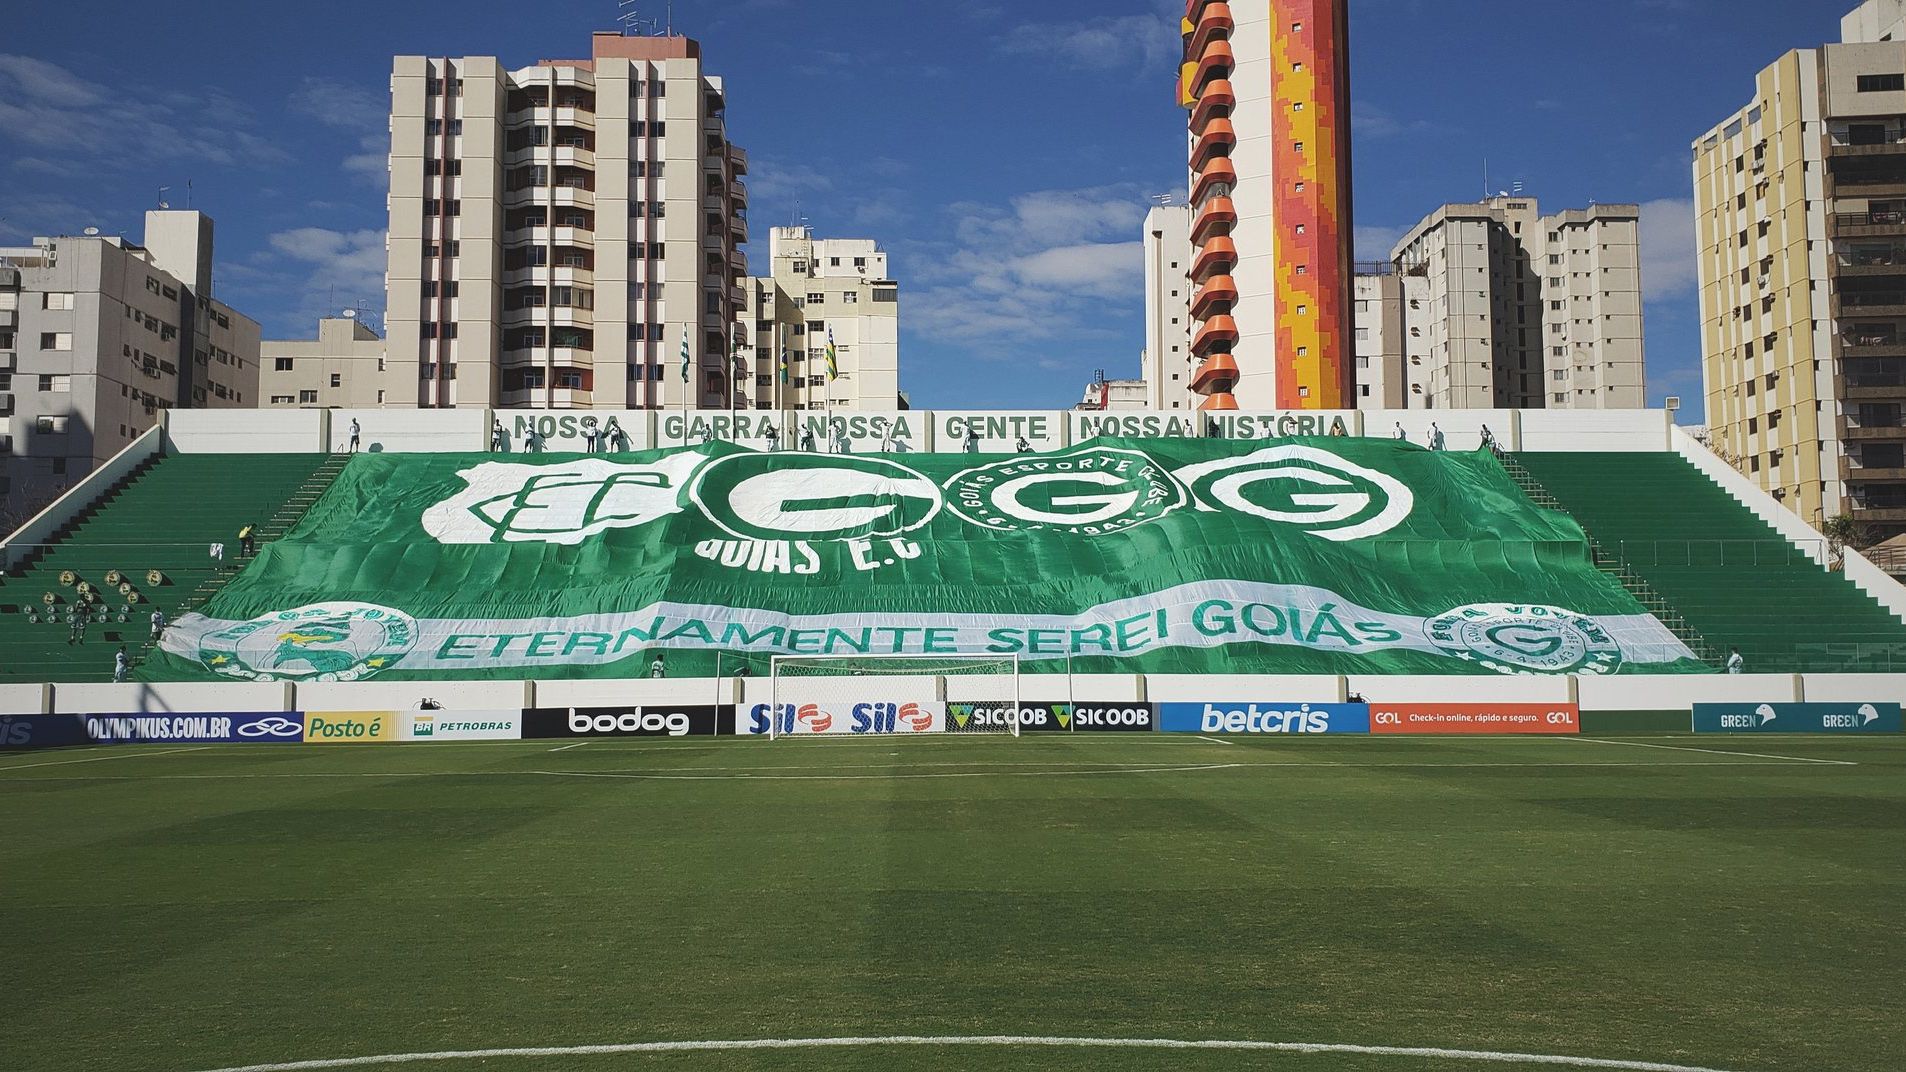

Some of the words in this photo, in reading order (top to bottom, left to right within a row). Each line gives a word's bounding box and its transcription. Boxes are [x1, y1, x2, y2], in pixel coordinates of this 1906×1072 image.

[515, 415, 623, 438] NOSSA
[807, 416, 912, 439] NOSSA
[1080, 416, 1182, 438] NOSSA
[999, 456, 1133, 475] ESPORTE
[435, 616, 957, 660] ETERNAMENTE
[986, 608, 1168, 653] SEREI
[1192, 599, 1402, 646] GOIÁS
[568, 707, 690, 735] bodog
[851, 703, 896, 734] Sil
[974, 708, 1047, 725] SICOOB
[1075, 708, 1149, 725] SICOOB
[1200, 703, 1329, 733] betcris
[1375, 712, 1401, 724] GOL
[1409, 713, 1444, 722] Check-in
[1446, 713, 1473, 723] online,
[1474, 712, 1501, 725] rápido
[1509, 715, 1539, 725] seguro.
[1546, 712, 1573, 724] GOL
[1720, 715, 1756, 727] GREEN
[1823, 715, 1859, 727] GREEN
[0, 717, 32, 745] is
[87, 717, 231, 739] OLYMPIKUS.COM.BR
[309, 718, 365, 736] Posto
[370, 717, 381, 736] é
[415, 723, 432, 732] BR
[440, 721, 512, 731] PETROBRAS
